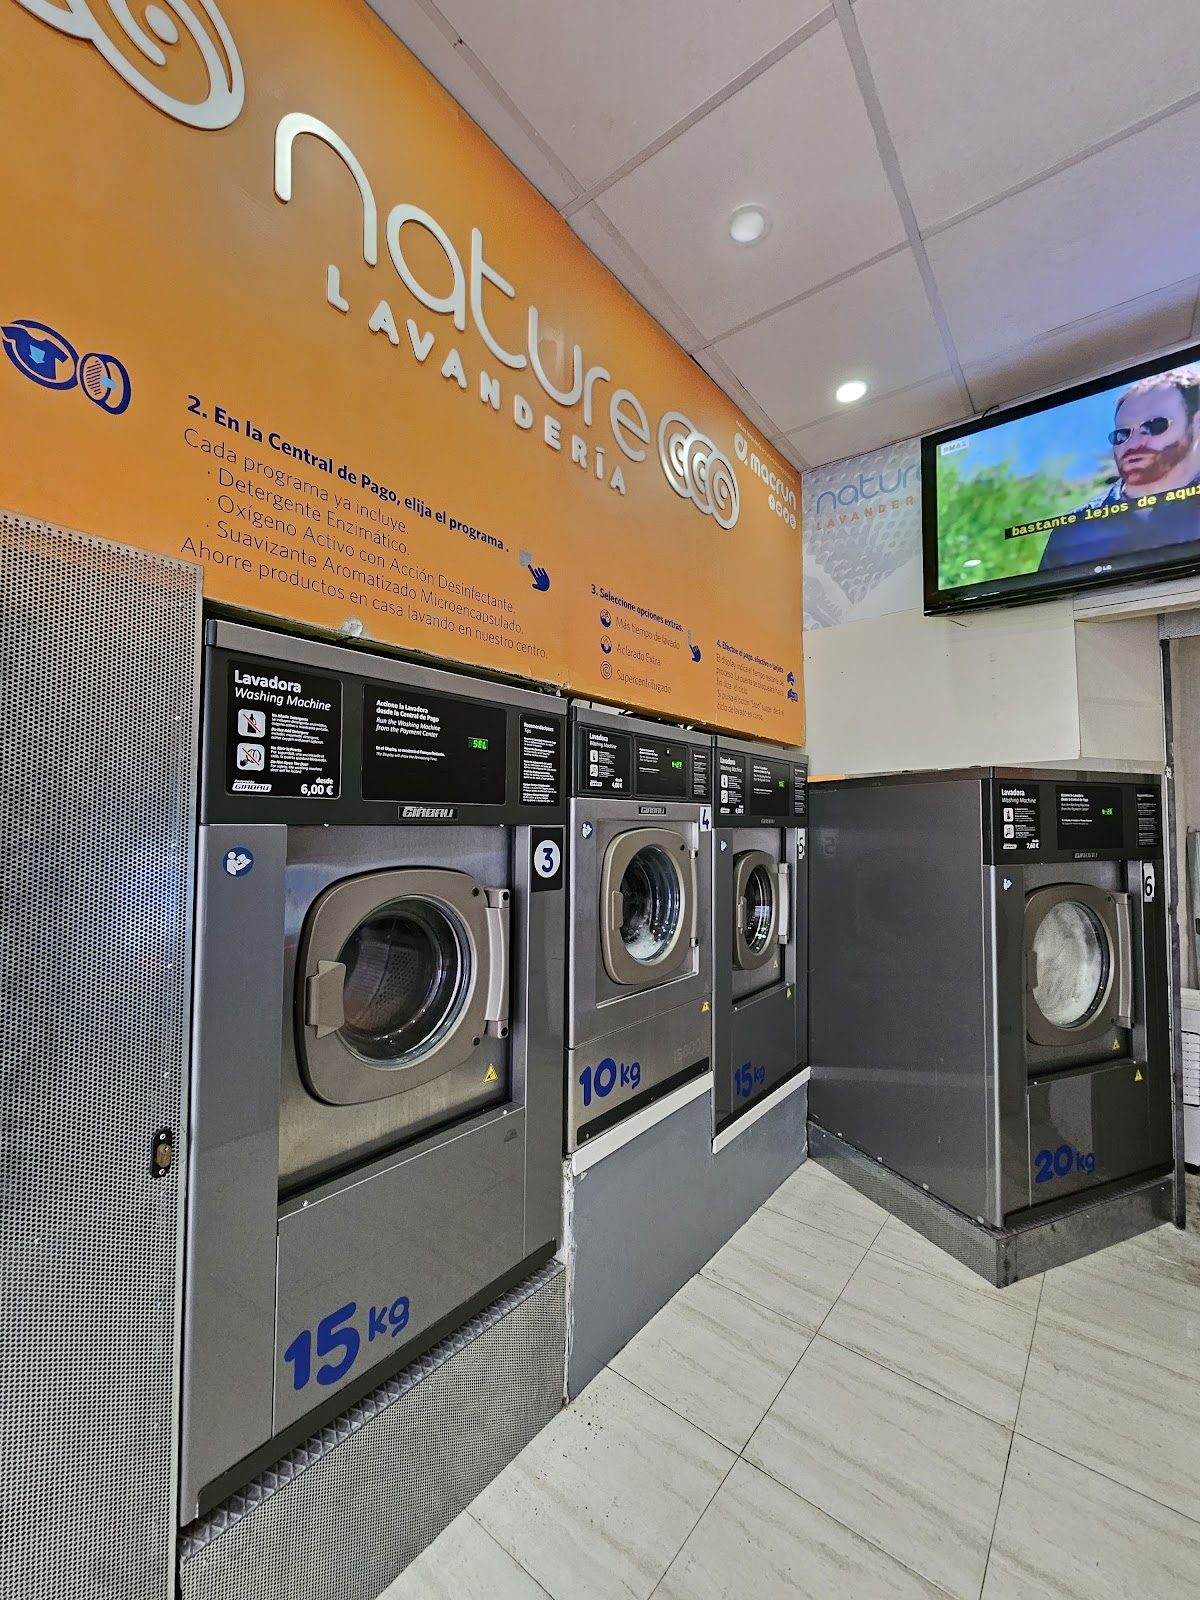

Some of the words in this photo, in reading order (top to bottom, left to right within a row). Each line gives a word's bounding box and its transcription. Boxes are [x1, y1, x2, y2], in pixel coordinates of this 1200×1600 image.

[274, 112, 651, 462] nature
[184, 428, 237, 463] Cada
[244, 456, 328, 501] programa
[334, 494, 351, 510] ya
[356, 500, 409, 535] incluye.
[187, 394, 207, 418] 2.
[214, 405, 239, 433] En
[246, 420, 262, 443] la
[268, 432, 333, 474] Central
[337, 465, 356, 485] de
[361, 474, 401, 506] Pago,
[404, 497, 432, 518] elija
[435, 511, 446, 524] el
[449, 517, 504, 550] programa
[219, 467, 321, 522] Detergente
[327, 511, 410, 556] Enzimático.
[1012, 513, 1077, 537] bastante
[1084, 502, 1129, 521] lejos
[1138, 496, 1157, 508] de
[217, 495, 297, 536] Oxígeno
[303, 526, 355, 557] Activo
[359, 550, 385, 568] con
[390, 557, 434, 584] Acción
[438, 574, 515, 614] Desinfectante.
[217, 520, 317, 568] Suavizante
[322, 557, 416, 600] Aromatizado
[421, 588, 523, 635] Microencapsulado.
[180, 537, 252, 573] Ahorre
[259, 563, 345, 600] productos
[350, 591, 368, 606] en
[372, 598, 403, 617] casa
[407, 605, 455, 632] lavando
[458, 624, 472, 637] en
[475, 630, 514, 649] nuestro
[516, 641, 548, 660] centro.
[591, 583, 598, 596] 3.
[599, 587, 636, 612] Seleccione
[636, 608, 664, 625] opciones
[631, 623, 653, 639] tiempo
[653, 631, 662, 643] de
[616, 643, 645, 661] Aclarado
[645, 652, 661, 666] Extra
[234, 669, 302, 693] Lavadora
[234, 686, 284, 706] Washing
[286, 695, 332, 711] Machine
[375, 699, 399, 709] Accione
[398, 702, 405, 710] la
[404, 704, 429, 714] Lavadora
[375, 706, 394, 716] desde
[393, 709, 400, 717] la
[399, 711, 419, 720] Central
[426, 715, 440, 724] Pago
[387, 718, 397, 726] the
[397, 720, 420, 730] Washing
[419, 723, 441, 732] Machine
[375, 724, 390, 732] from
[390, 726, 399, 734] the
[399, 727, 422, 737] Payment
[300, 783, 325, 796] 6,00
[326, 785, 334, 795] €
[315, 777, 334, 785] desde
[1001, 788, 1025, 796] Lavadora
[702, 808, 710, 829] 4
[541, 847, 554, 873] 3
[1145, 875, 1153, 897] 6
[579, 1057, 618, 1107] 10
[734, 1061, 753, 1099] 15
[1034, 1144, 1075, 1184] 20
[283, 1301, 360, 1392] 15
